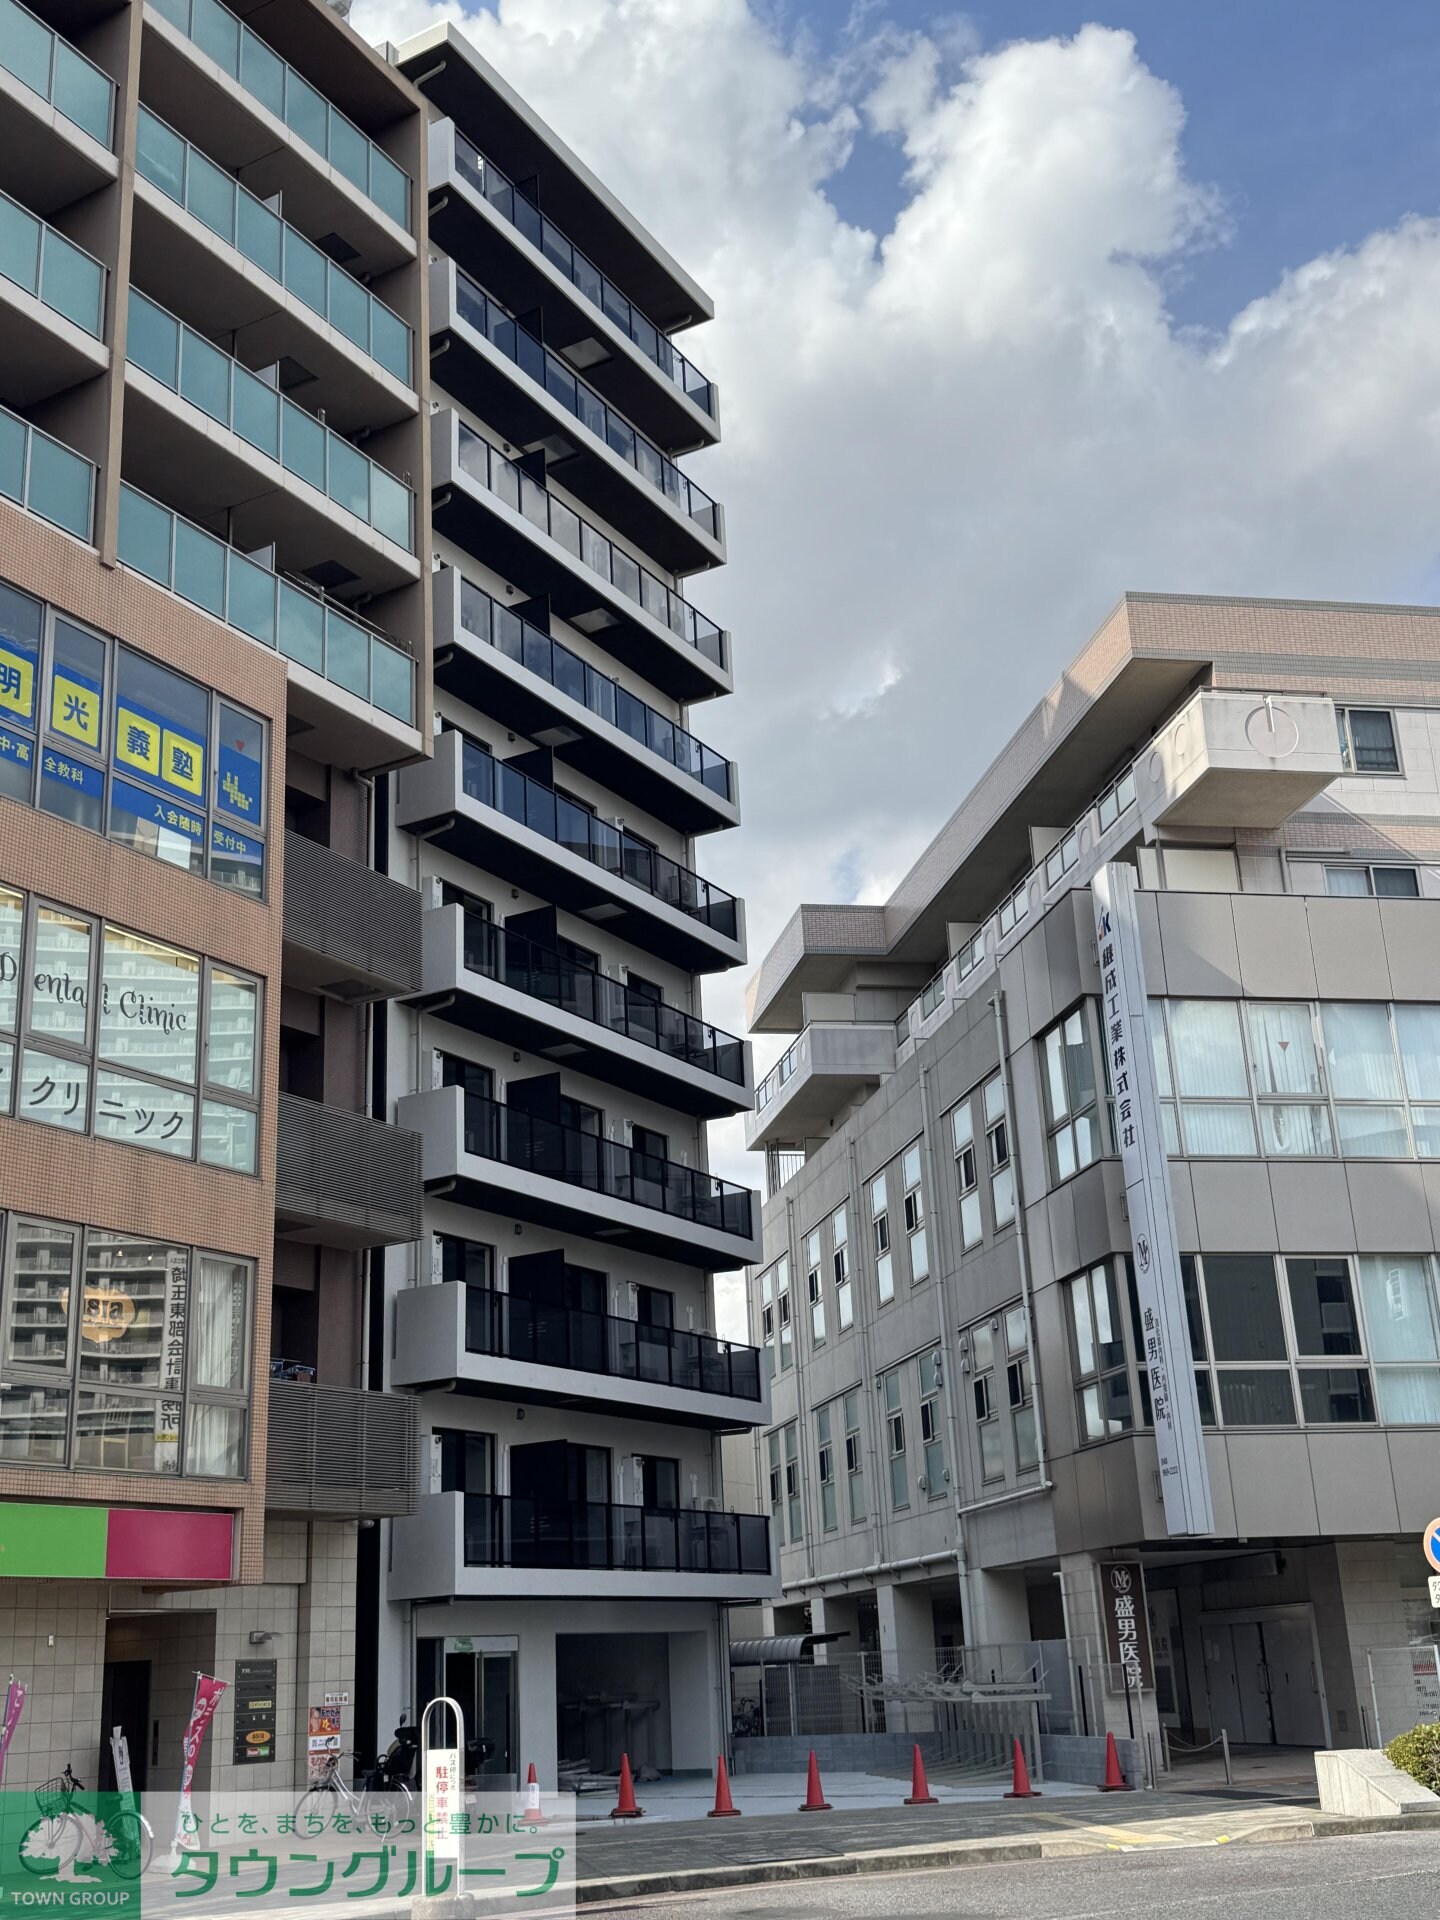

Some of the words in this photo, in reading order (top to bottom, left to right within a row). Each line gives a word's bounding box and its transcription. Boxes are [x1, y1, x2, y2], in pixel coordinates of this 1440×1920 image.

[0, 662, 194, 782] 明光義塾
[44, 757, 83, 785] 全教科
[154, 804, 202, 836] 入会随時
[214, 830, 246, 854] 受付中
[119, 989, 188, 1035] Clinic
[1102, 943, 1136, 1149] 継成工業株式会社
[84, 1298, 124, 1320] sia
[1143, 1307, 1166, 1422] 盛男医院
[1114, 1594, 1144, 1688] 盛男医院
[435, 1766, 448, 1840] 駐停車禁止
